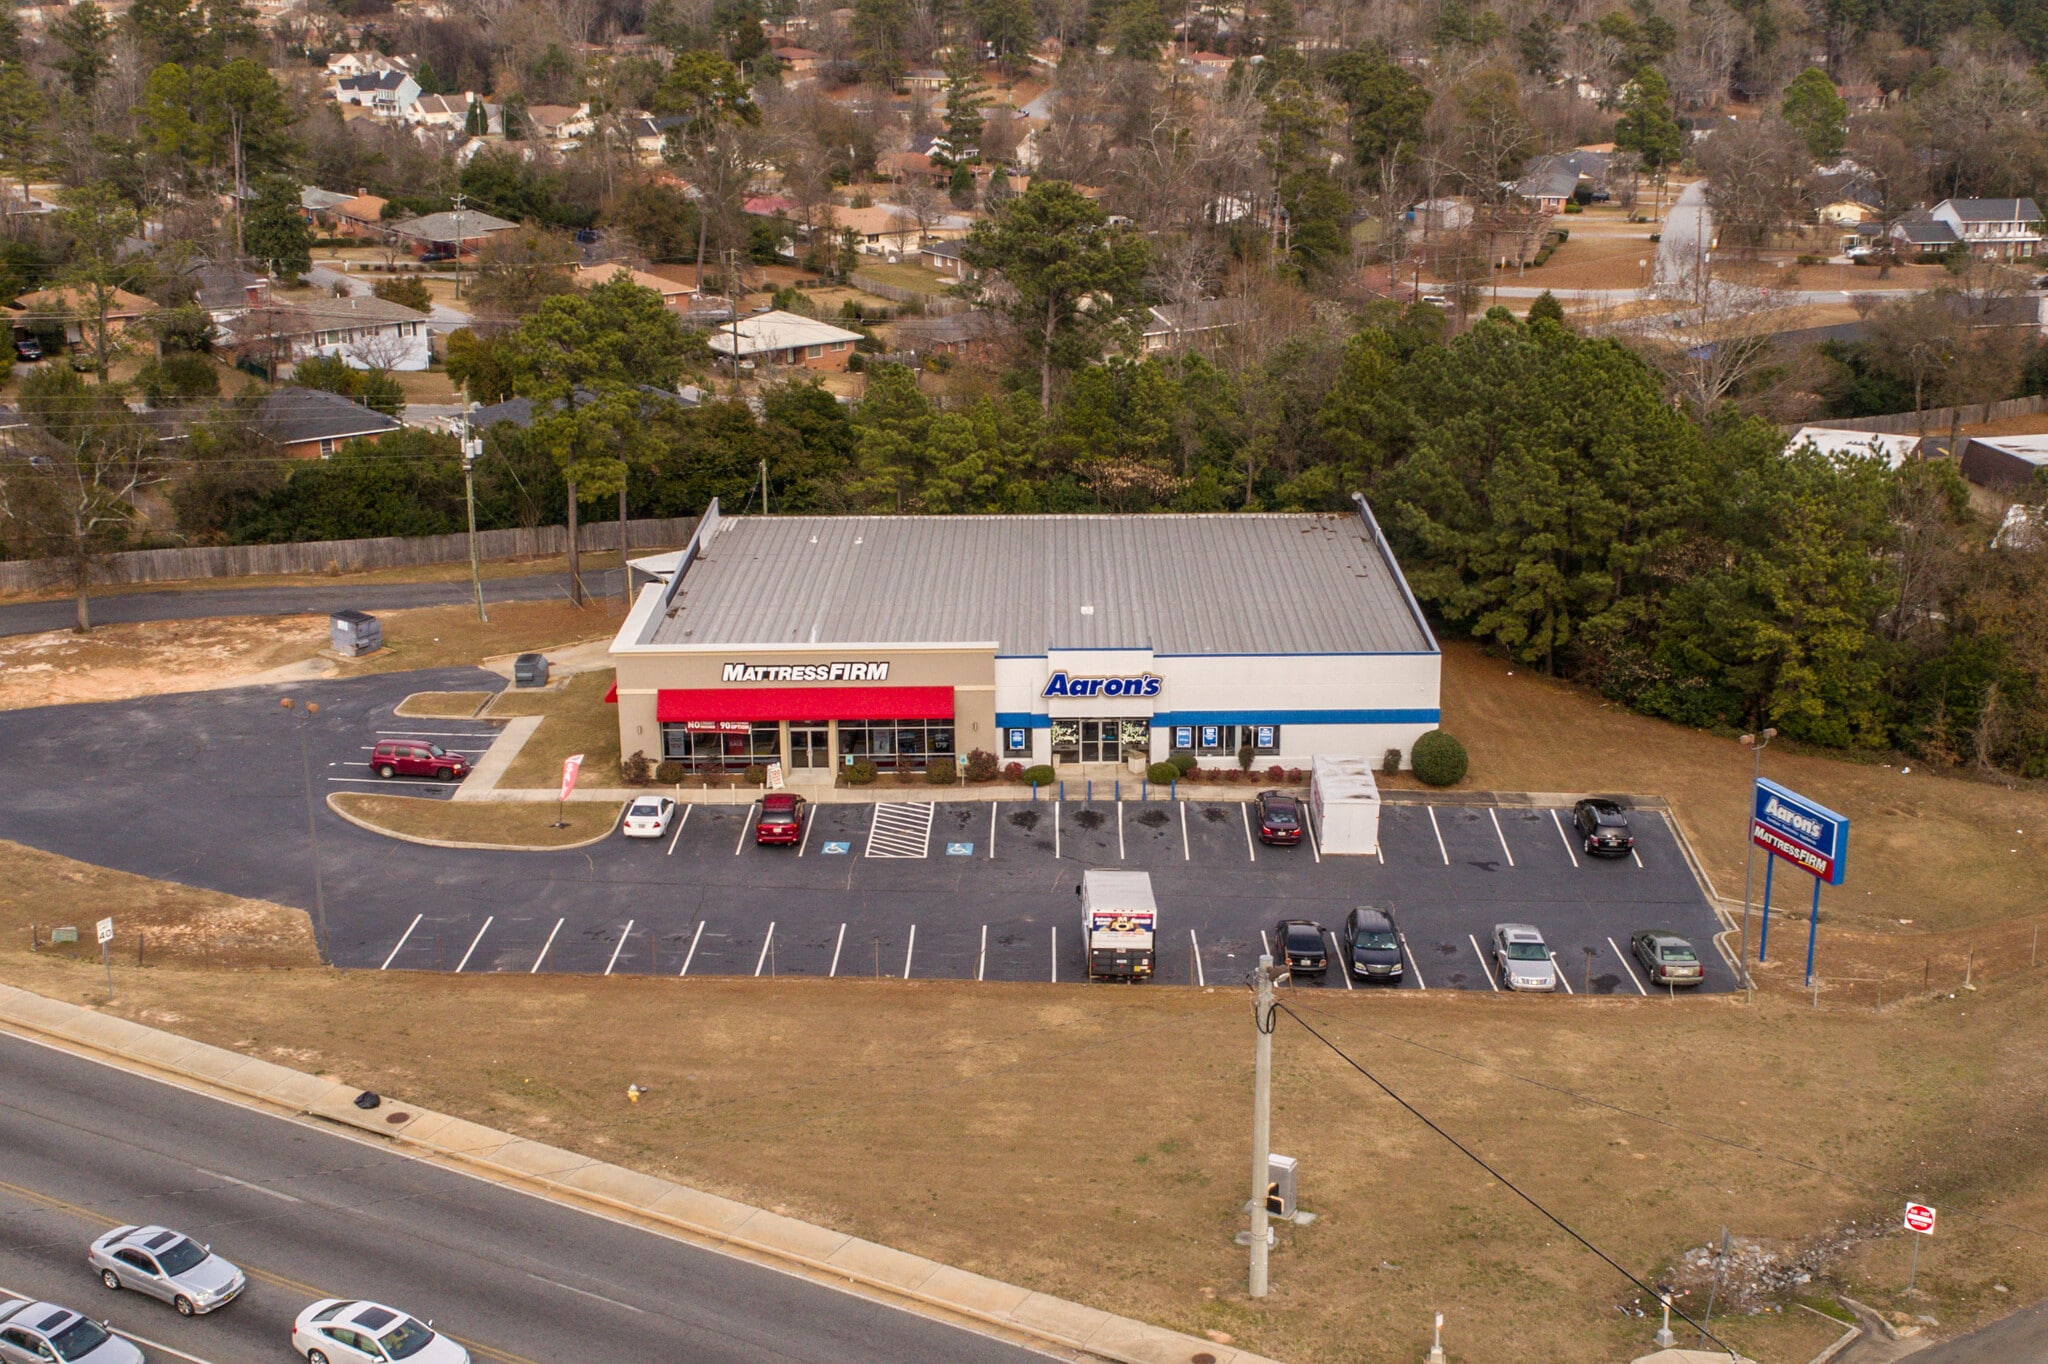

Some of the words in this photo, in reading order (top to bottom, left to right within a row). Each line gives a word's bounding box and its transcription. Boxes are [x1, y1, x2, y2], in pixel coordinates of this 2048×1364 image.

[1043, 672, 1161, 697] Aaron's
[687, 721, 700, 729] NO
[560, 762, 574, 798] SALE
[1765, 798, 1820, 838] Aaron's
[99, 929, 112, 939] 40
